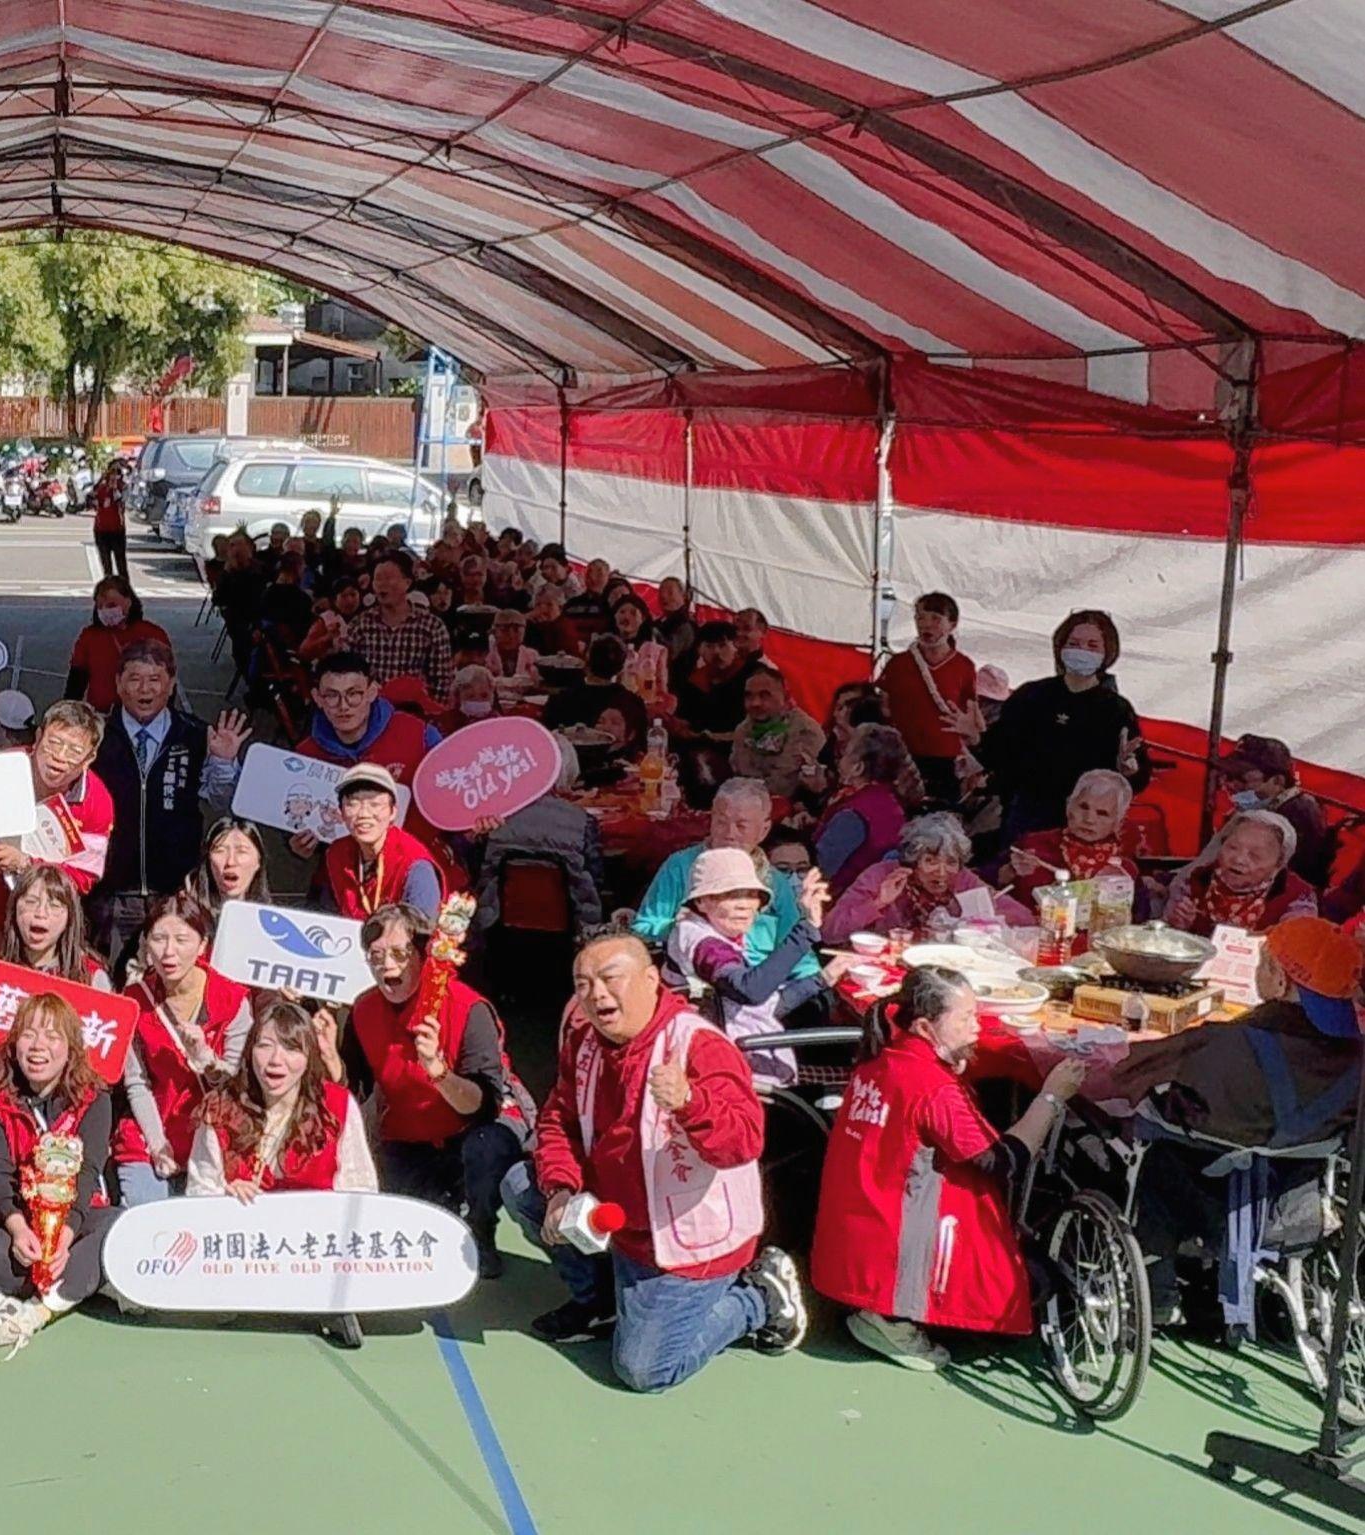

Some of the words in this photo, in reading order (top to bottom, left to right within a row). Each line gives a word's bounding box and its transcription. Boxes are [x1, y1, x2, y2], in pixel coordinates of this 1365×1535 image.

[464, 773, 499, 810] Old
[498, 747, 539, 796] yes!
[247, 957, 346, 996] TAAT
[202, 1230, 439, 1260] 財團法人老五老基金會
[136, 1258, 176, 1276] OFO
[202, 1262, 234, 1275] OLD
[244, 1262, 281, 1275] FIVE
[290, 1261, 321, 1275] OLD
[333, 1260, 435, 1275] FOUNDATION
